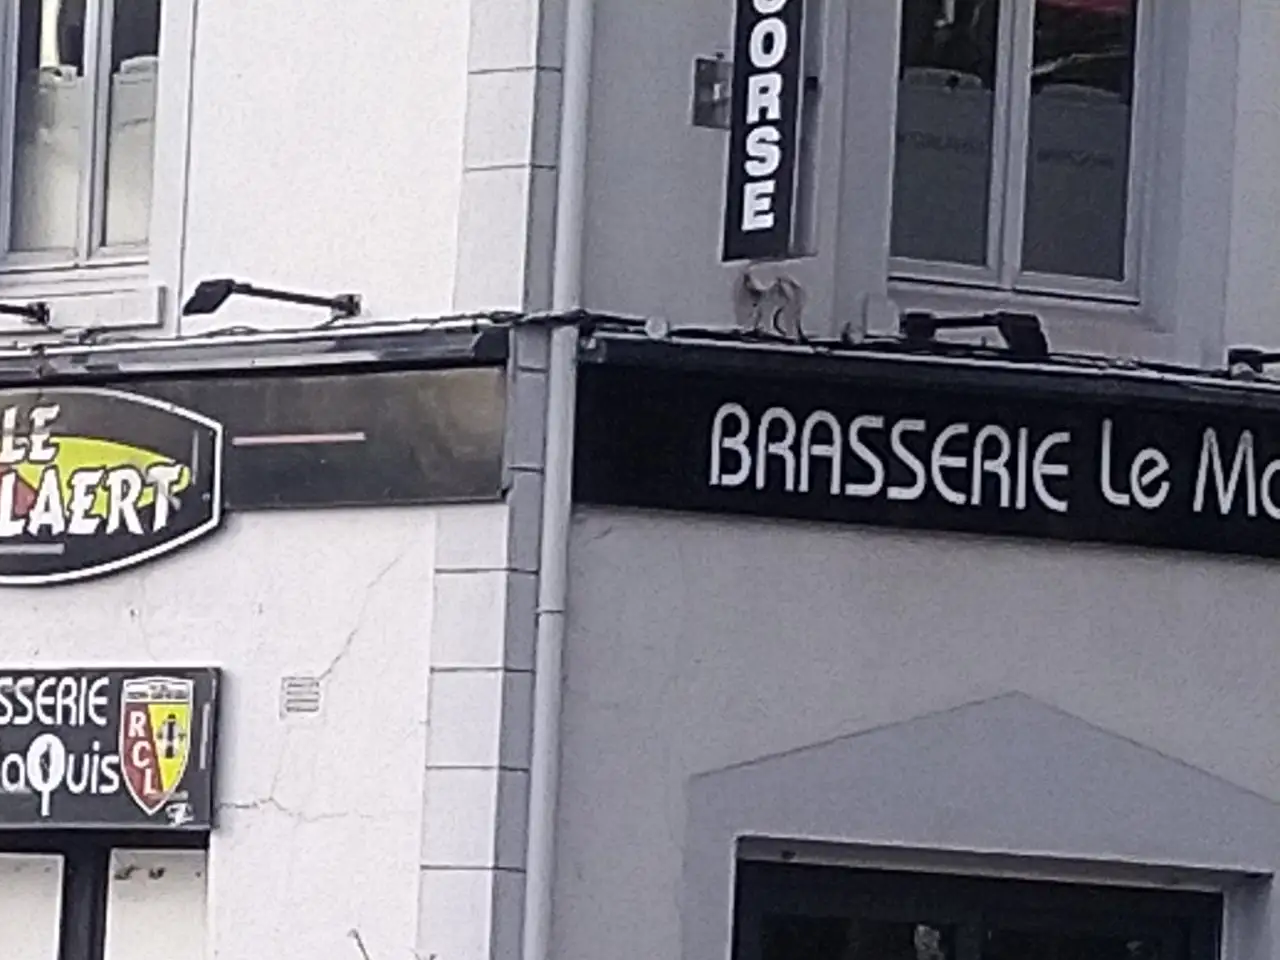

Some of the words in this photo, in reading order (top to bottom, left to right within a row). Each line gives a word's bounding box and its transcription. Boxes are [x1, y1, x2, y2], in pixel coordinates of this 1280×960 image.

[709, 402, 1070, 512] BRASSERIE
[1101, 418, 1169, 509] Le
[128, 710, 158, 796] RCL
